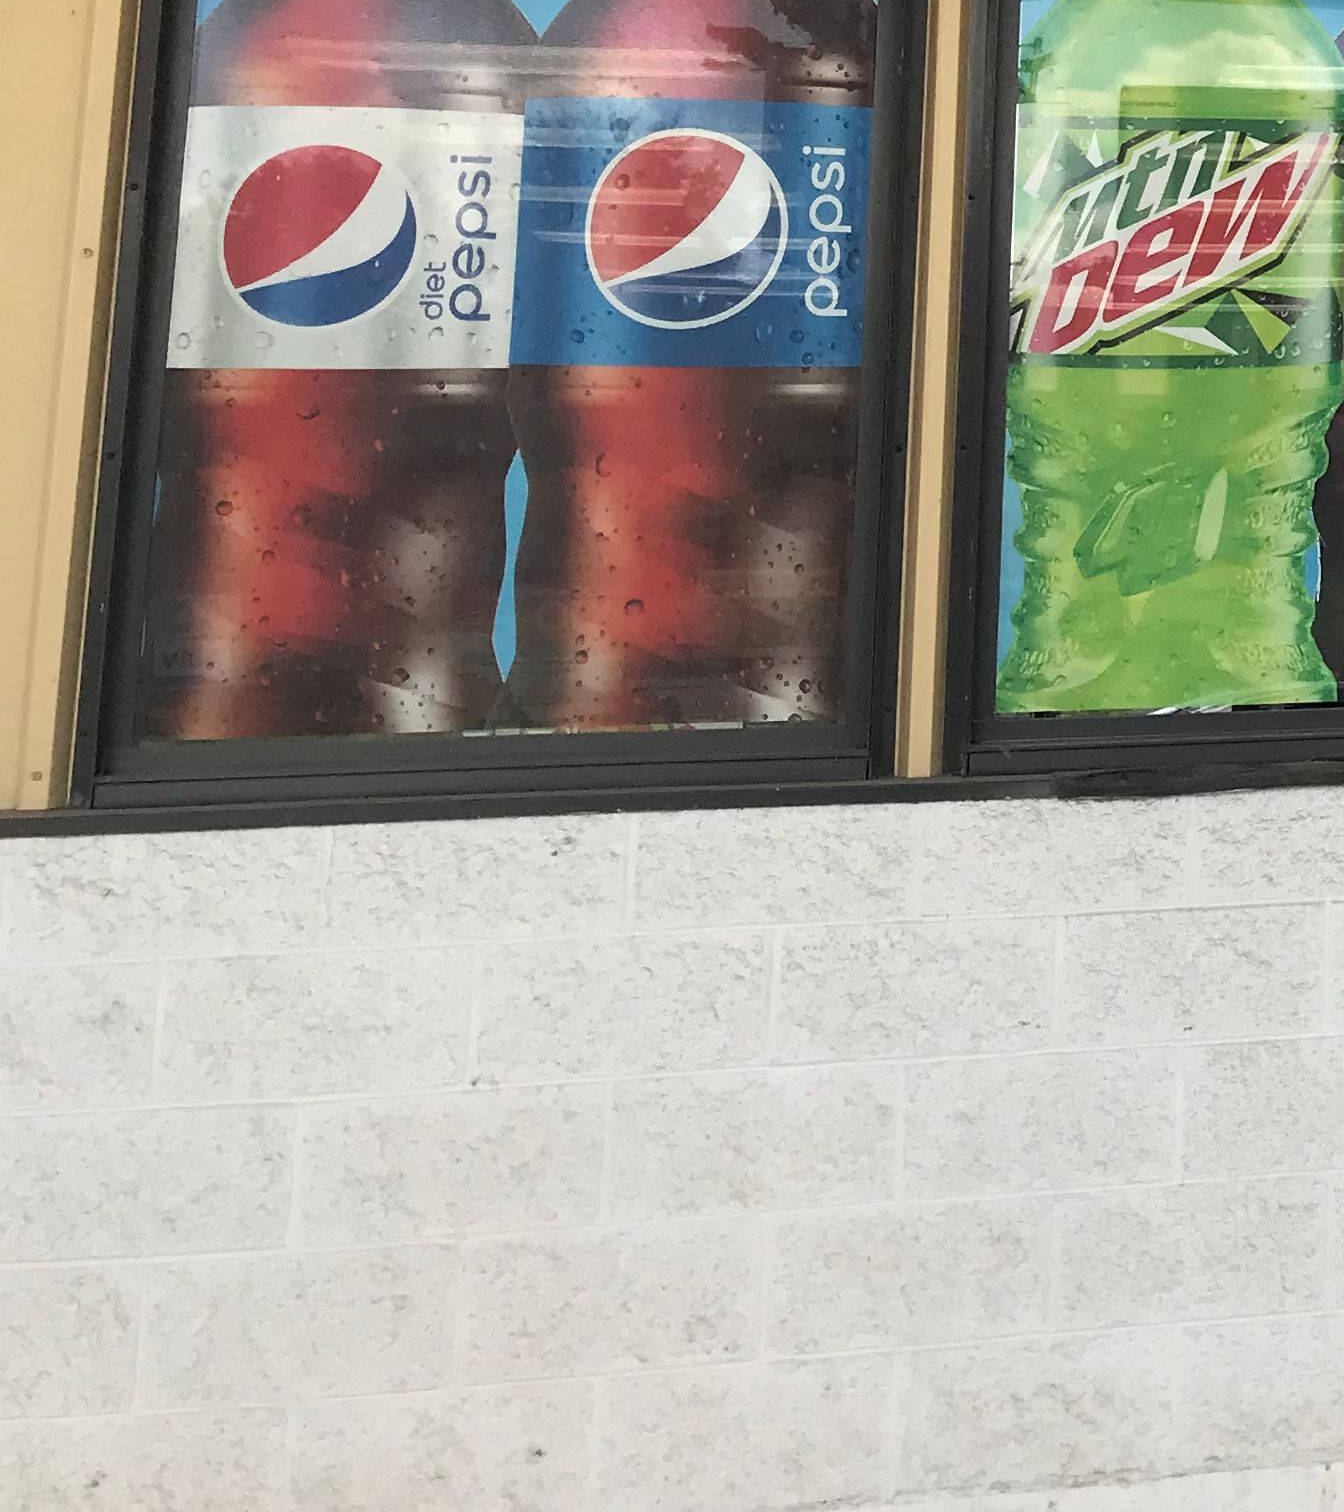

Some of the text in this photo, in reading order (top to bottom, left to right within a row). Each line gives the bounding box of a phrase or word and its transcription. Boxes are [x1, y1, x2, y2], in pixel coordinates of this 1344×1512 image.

[419, 262, 447, 320] diet
[449, 154, 497, 322] pepsi
[802, 145, 852, 317] pepsi
